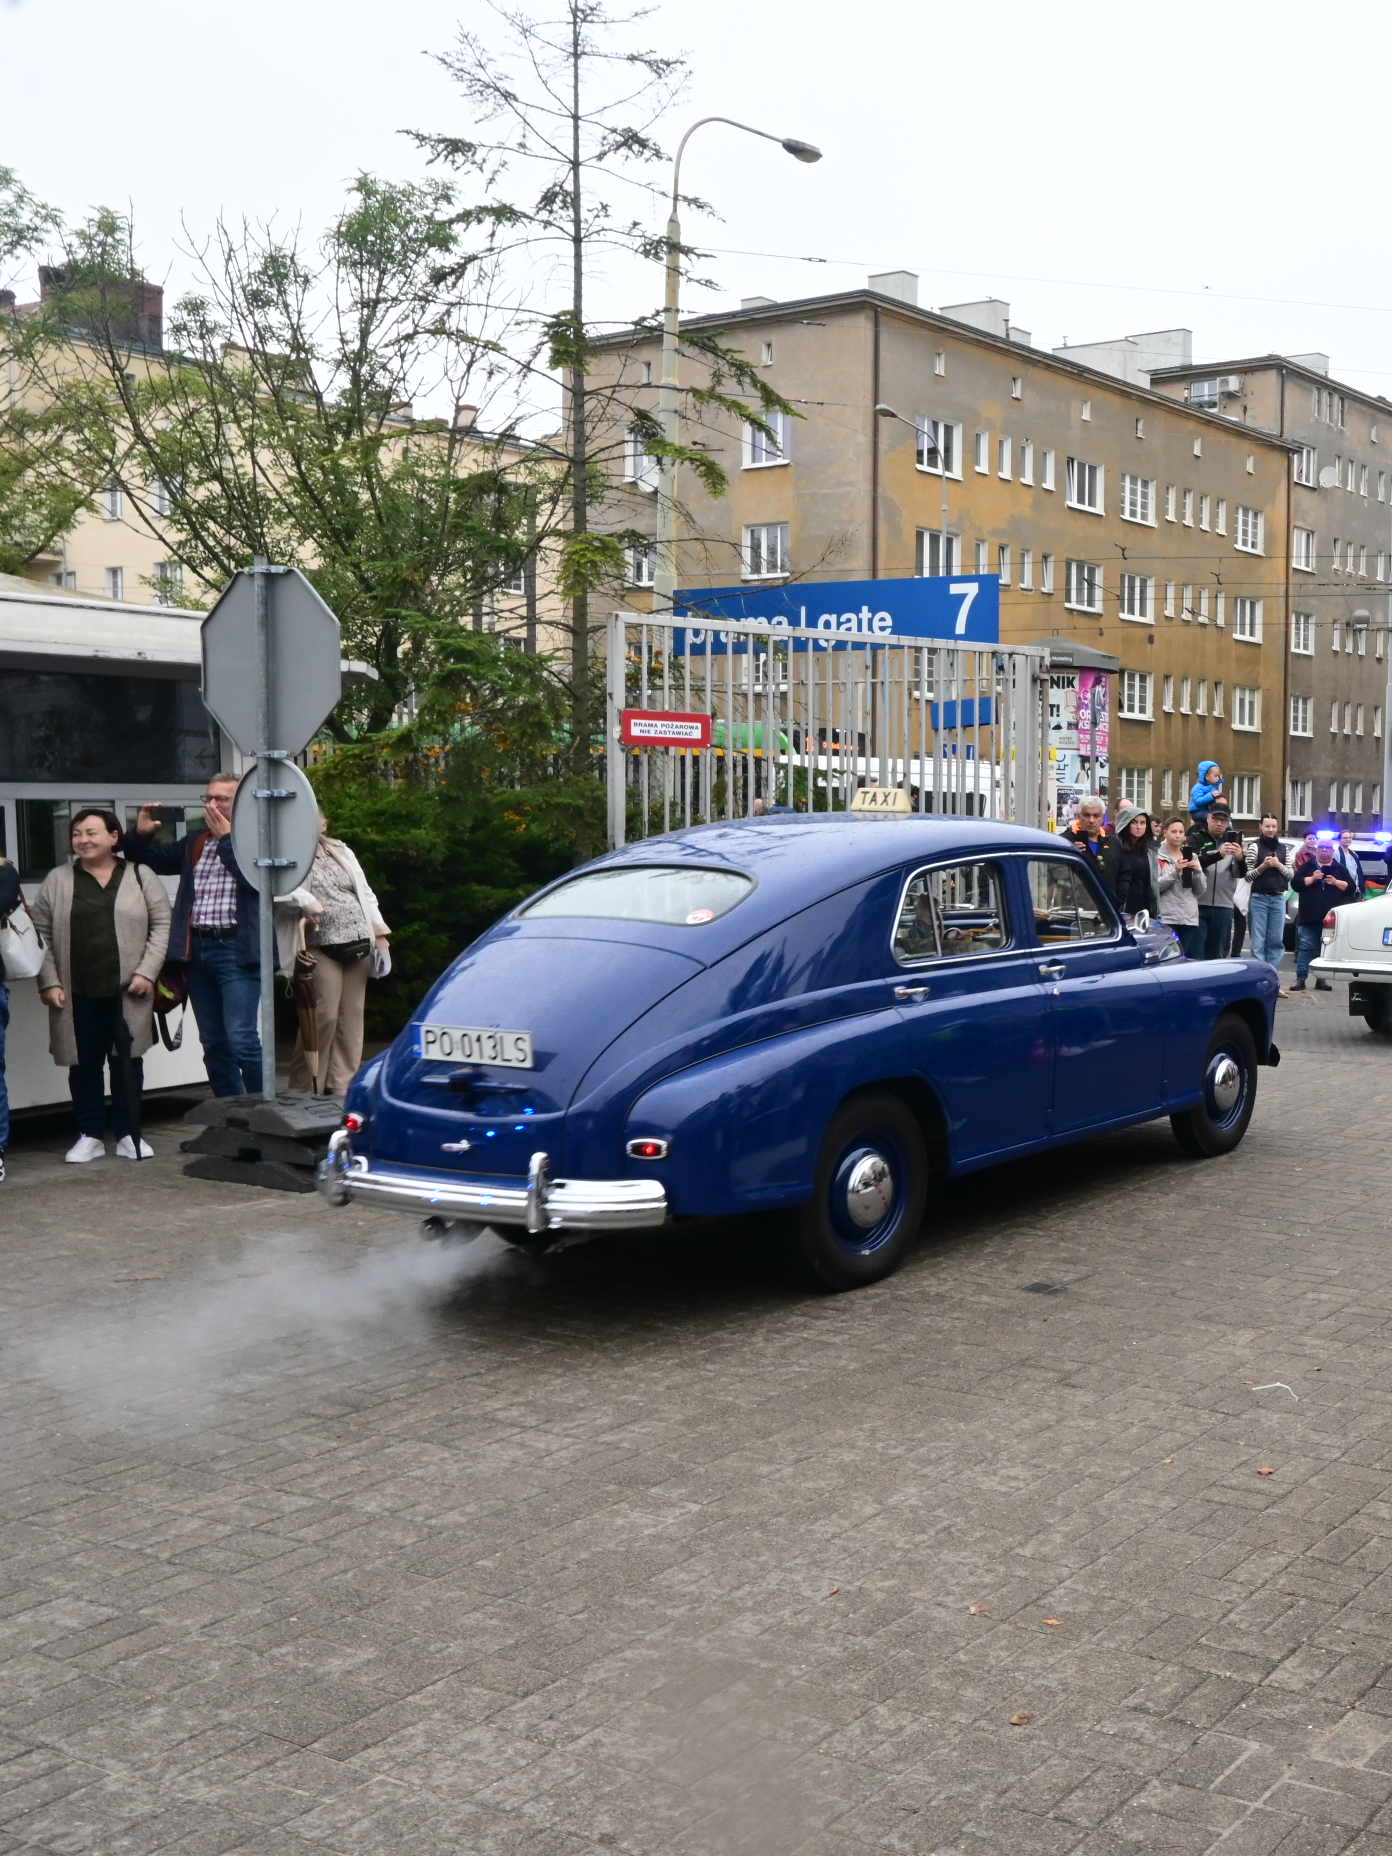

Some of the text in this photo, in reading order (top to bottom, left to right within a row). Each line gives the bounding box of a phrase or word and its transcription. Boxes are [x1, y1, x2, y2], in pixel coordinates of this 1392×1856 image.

[817, 605, 893, 648] gate
[949, 582, 979, 635] 7
[633, 721, 699, 731] BRAMA POŻAROWA
[860, 790, 898, 806] TAXI
[425, 1030, 528, 1063] PO 013LS
